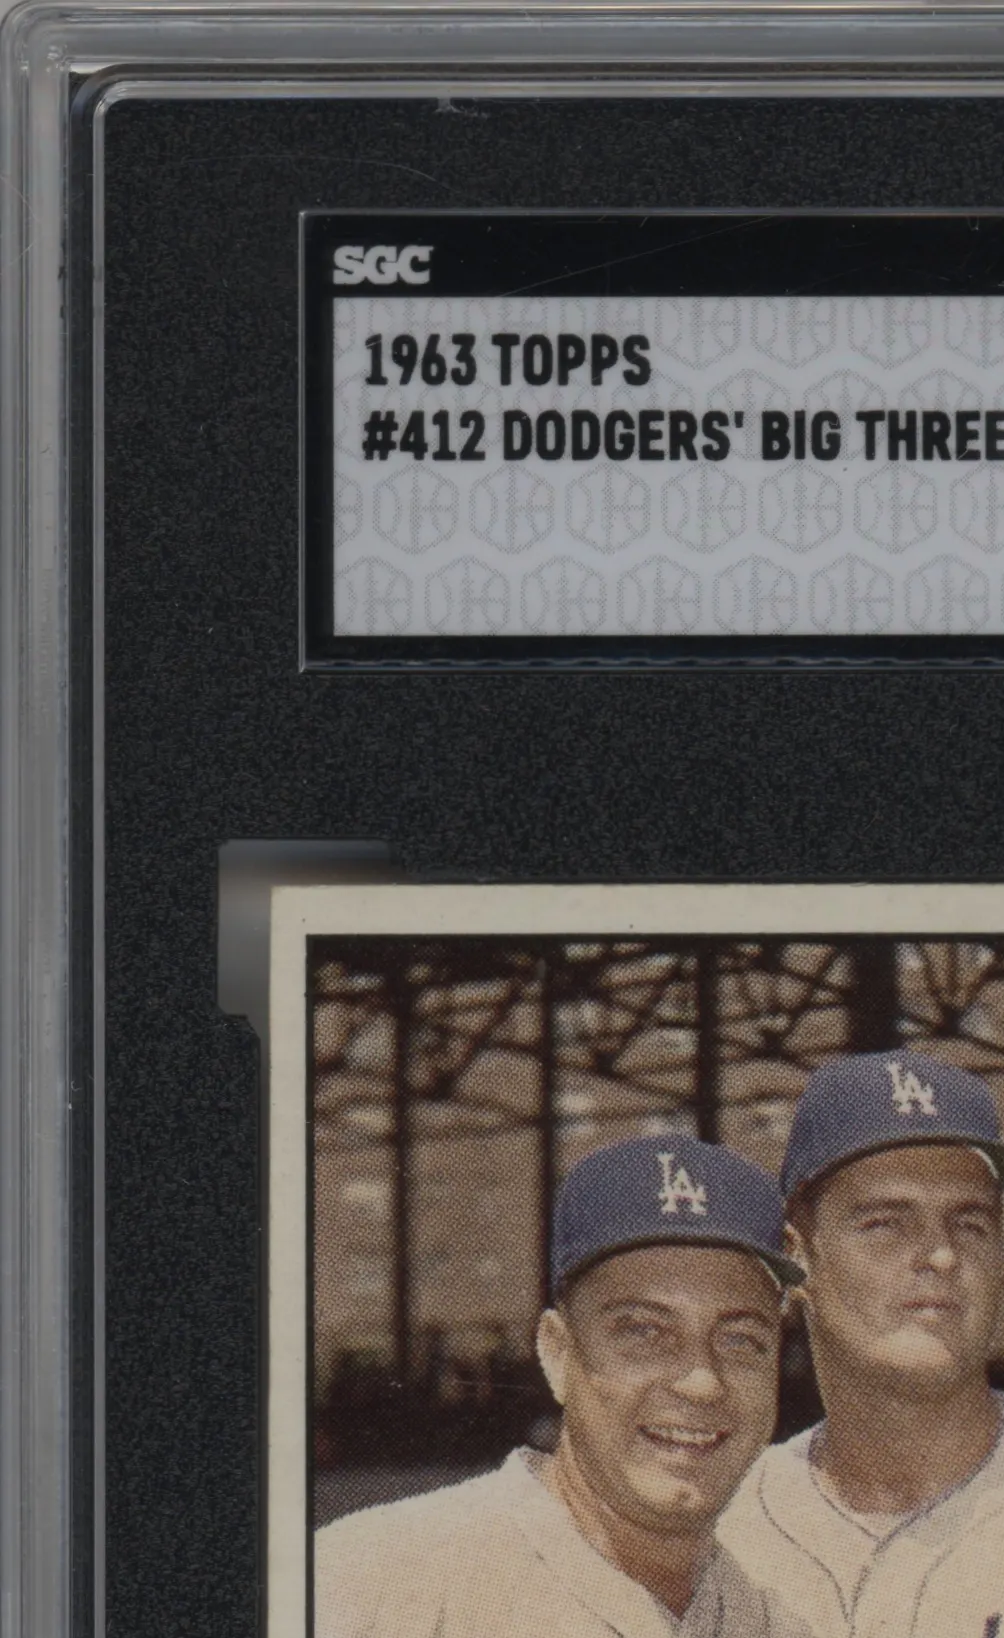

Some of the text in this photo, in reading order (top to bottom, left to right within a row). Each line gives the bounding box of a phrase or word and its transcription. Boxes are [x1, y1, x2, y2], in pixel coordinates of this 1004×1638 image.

[333, 245, 434, 285] SGC
[364, 333, 652, 386] 1963 TOPPS
[362, 409, 487, 462] #412
[503, 409, 744, 462] DODGERS'
[761, 409, 842, 462] BIG
[887, 1062, 938, 1116] LA
[656, 1151, 707, 1216] LA
